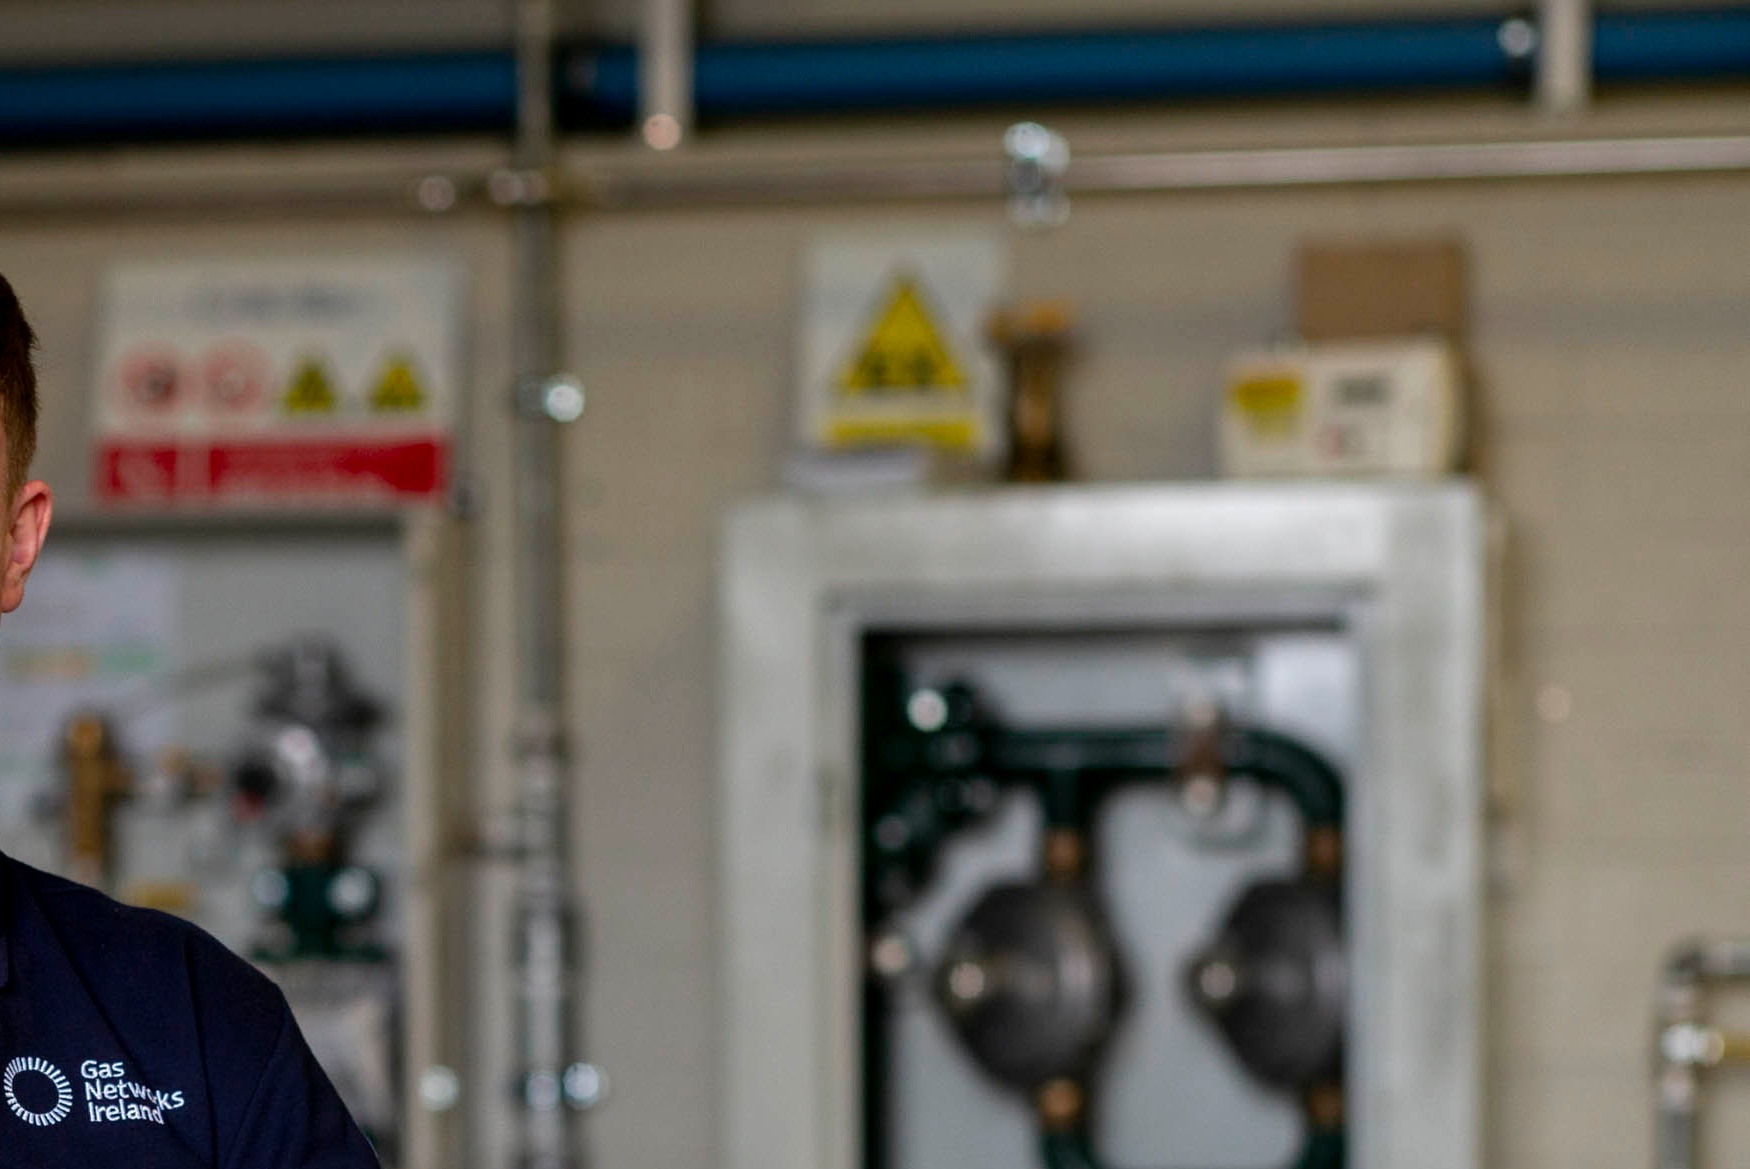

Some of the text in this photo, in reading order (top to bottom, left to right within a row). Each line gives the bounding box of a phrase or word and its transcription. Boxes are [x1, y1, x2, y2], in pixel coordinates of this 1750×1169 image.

[81, 1060, 125, 1079] Gas
[84, 1079, 185, 1111] Netwoks
[88, 1099, 165, 1125] Ireland
